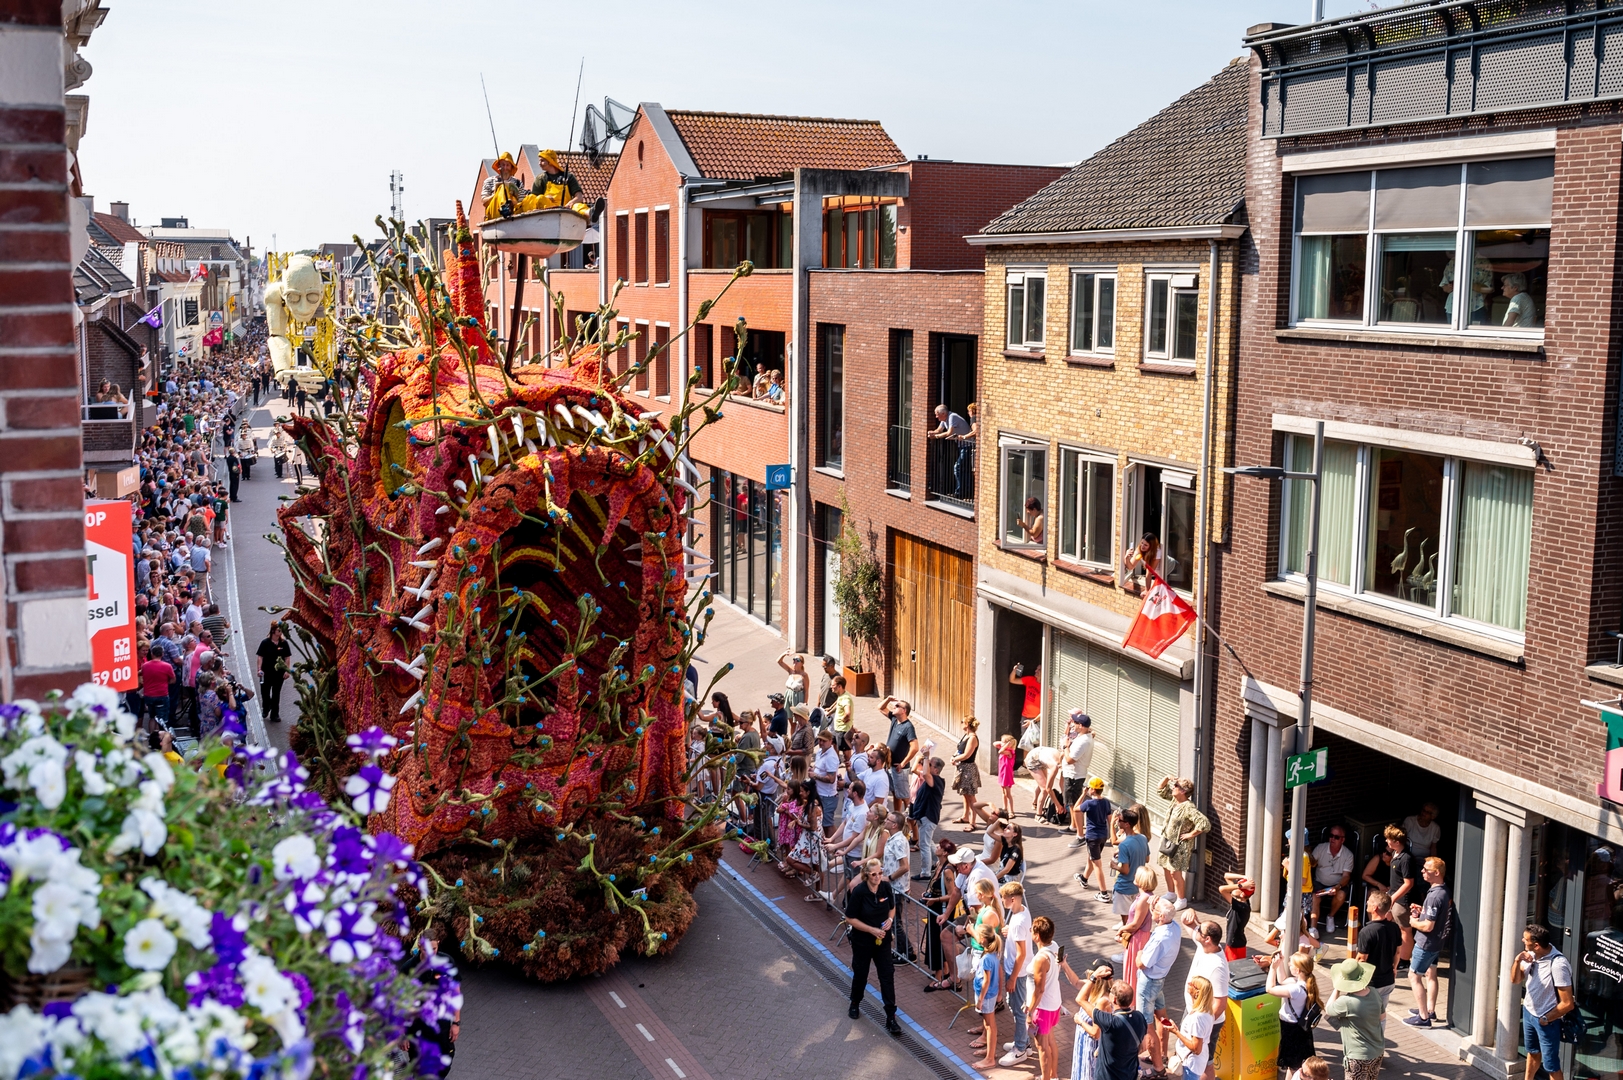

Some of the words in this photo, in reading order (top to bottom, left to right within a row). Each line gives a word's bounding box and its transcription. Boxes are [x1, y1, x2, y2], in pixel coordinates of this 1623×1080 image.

[84, 511, 107, 527] OP
[114, 654, 131, 663] NVM
[112, 666, 132, 683] 00
